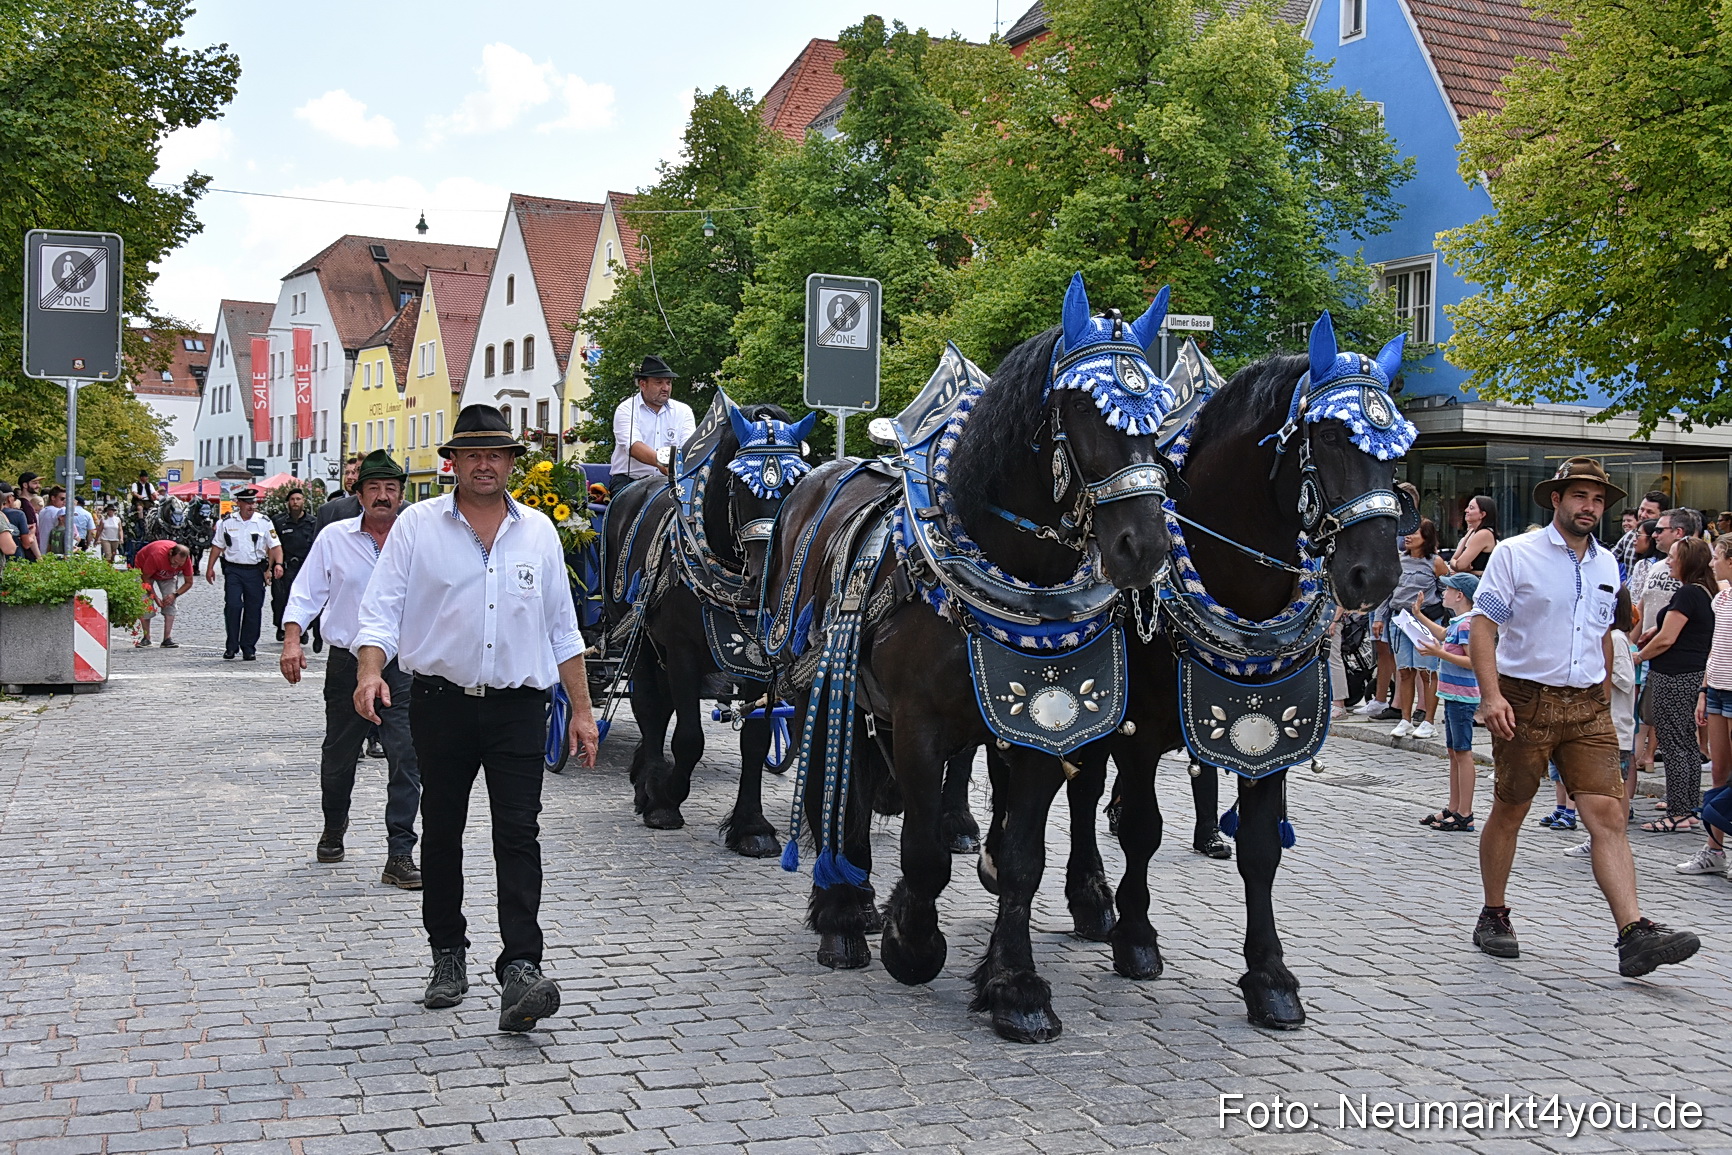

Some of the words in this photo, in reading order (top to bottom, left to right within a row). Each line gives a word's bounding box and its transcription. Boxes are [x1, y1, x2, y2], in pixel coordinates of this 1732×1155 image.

[57, 296, 91, 307] ZONE
[1171, 317, 1189, 327] Ulmer
[1191, 317, 1211, 327] Gasse
[830, 333, 856, 345] ZONE
[253, 372, 267, 410] SALE
